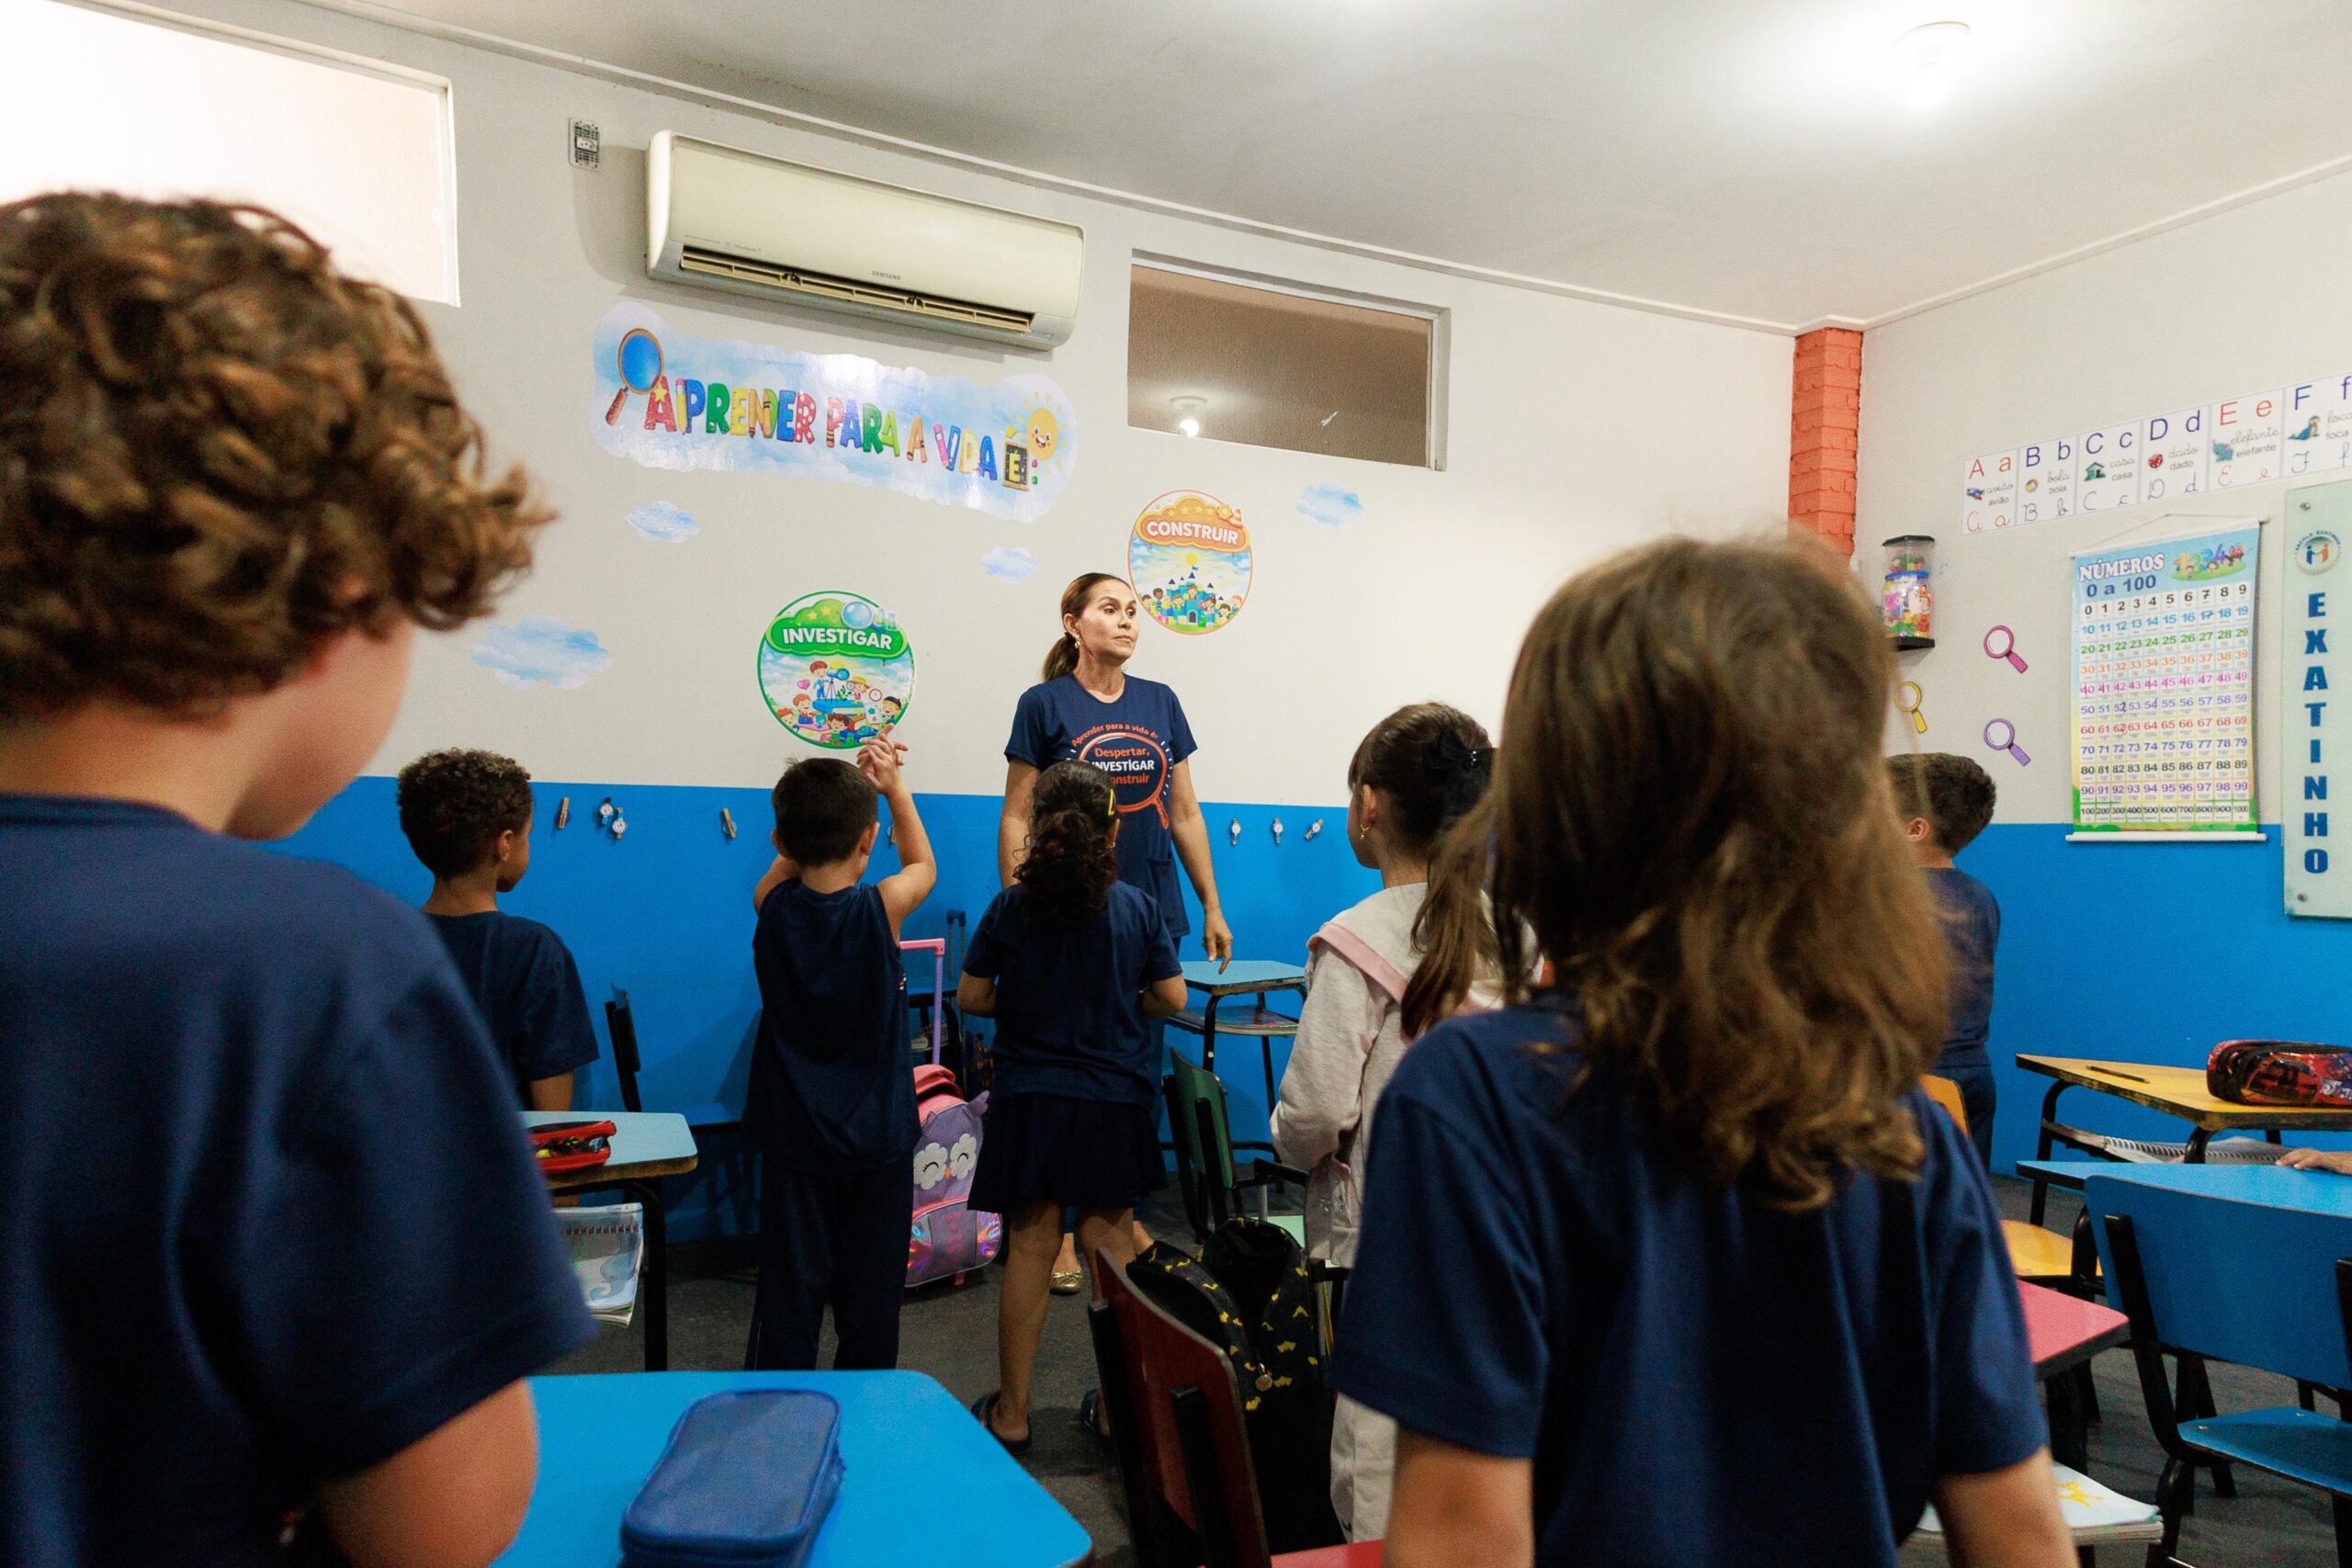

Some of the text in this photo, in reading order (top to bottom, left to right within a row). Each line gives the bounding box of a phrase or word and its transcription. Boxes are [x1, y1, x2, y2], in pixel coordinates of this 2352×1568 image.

[2294, 375, 2352, 411] F f
[2220, 400, 2272, 425] E e
[826, 397, 900, 457] PARA
[907, 415, 927, 463] A
[2150, 409, 2200, 441] D d
[2026, 440, 2071, 468] B b
[2086, 432, 2132, 454] C c
[1969, 457, 2012, 479] A a
[1146, 521, 1238, 546] CONSTRUIR
[2079, 552, 2165, 582] NÚMEROS
[2086, 575, 2156, 598] 0 a 100
[2085, 605, 2092, 615] 0
[2102, 604, 2108, 613] 1
[2118, 601, 2125, 611] 2
[2133, 599, 2141, 608] 3
[2148, 596, 2156, 605] 4
[2166, 593, 2174, 604] 5
[2184, 592, 2193, 602] 6
[2202, 590, 2210, 600] 7
[2221, 587, 2229, 597] 8
[2239, 584, 2246, 594] 9
[2083, 625, 2095, 634] 10
[2099, 623, 2110, 632] 11
[2116, 621, 2127, 630] 12
[2131, 618, 2143, 628] 13
[2146, 616, 2159, 626] 14
[2163, 615, 2177, 624] 15
[2181, 612, 2196, 622] 16
[2218, 608, 2232, 618] 18
[2236, 605, 2249, 615] 19
[783, 627, 893, 649] INVESTIGAR
[2081, 645, 2096, 654] 20
[2098, 644, 2110, 653] 21
[2115, 641, 2127, 650] 22
[2130, 639, 2143, 649] 23
[2145, 637, 2159, 647] 24
[2162, 635, 2177, 645] 25
[2180, 634, 2196, 643] 26
[2199, 631, 2213, 641] 27
[2218, 630, 2232, 639] 28
[2235, 627, 2249, 637] 29
[2081, 705, 2095, 715] 50
[2098, 705, 2109, 713] 51
[2128, 702, 2141, 711] 53
[2162, 699, 2176, 707] 55
[2179, 698, 2194, 706] 56
[2198, 696, 2213, 705] 57
[2217, 695, 2232, 705] 58
[2234, 694, 2247, 703] 59
[1071, 725, 1104, 747] Aprender
[1105, 723, 1124, 731] para
[1132, 725, 1148, 735] vida
[2080, 726, 2095, 734] 60
[2098, 725, 2109, 733] 61
[2127, 722, 2141, 731] 63
[2143, 721, 2158, 730] 64
[2161, 720, 2176, 729] 65
[2178, 719, 2193, 728] 66
[2197, 717, 2212, 728] 67
[2216, 716, 2231, 726] 68
[2234, 716, 2247, 725] 69
[2303, 592, 2328, 874] EXATINHO
[1094, 748, 1150, 759] Despertar,
[2081, 738, 2247, 754] 70 71 72 73 74 75 76 77 78 79
[2081, 760, 2248, 774] 80 81 82 83 84 85 86 87 88 89
[2081, 782, 2248, 795] 90 91 92 93 94 95 96 97 98 99
